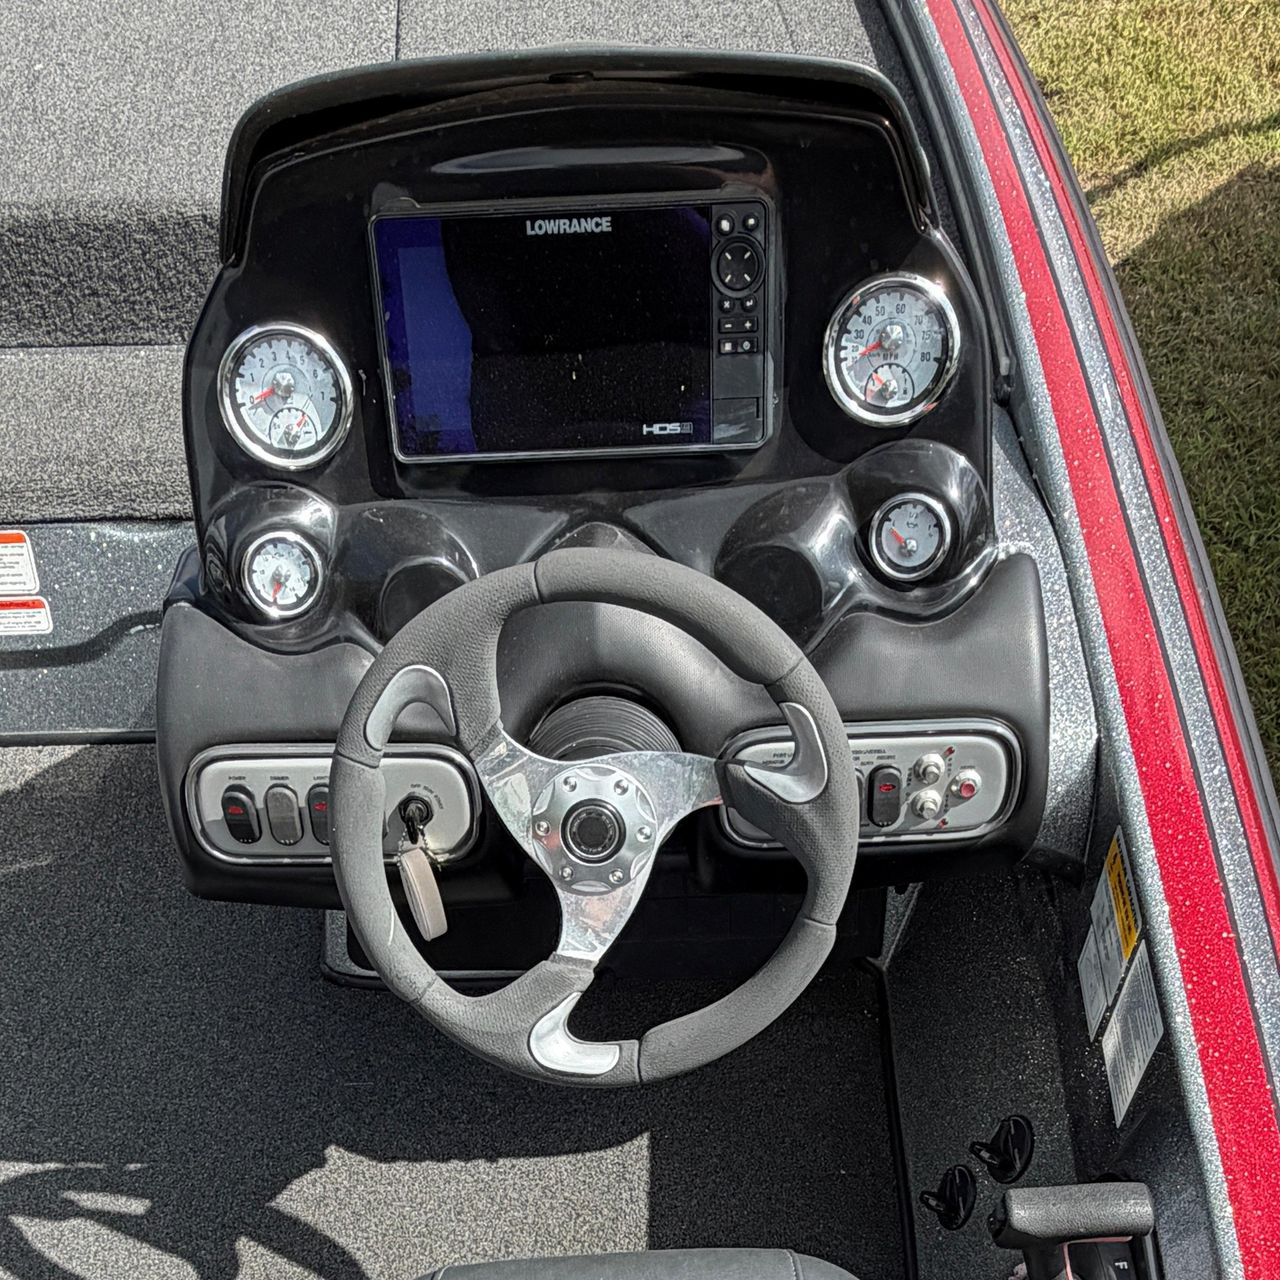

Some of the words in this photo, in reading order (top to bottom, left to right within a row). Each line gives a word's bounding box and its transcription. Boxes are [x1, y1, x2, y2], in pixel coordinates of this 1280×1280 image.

[526, 216, 612, 236] LOWRANCE
[875, 305, 886, 316] 50
[895, 303, 906, 314] 60
[853, 329, 864, 340] 30
[920, 351, 931, 362] 80
[642, 422, 680, 435] HDS
[1114, 1261, 1128, 1270] F
